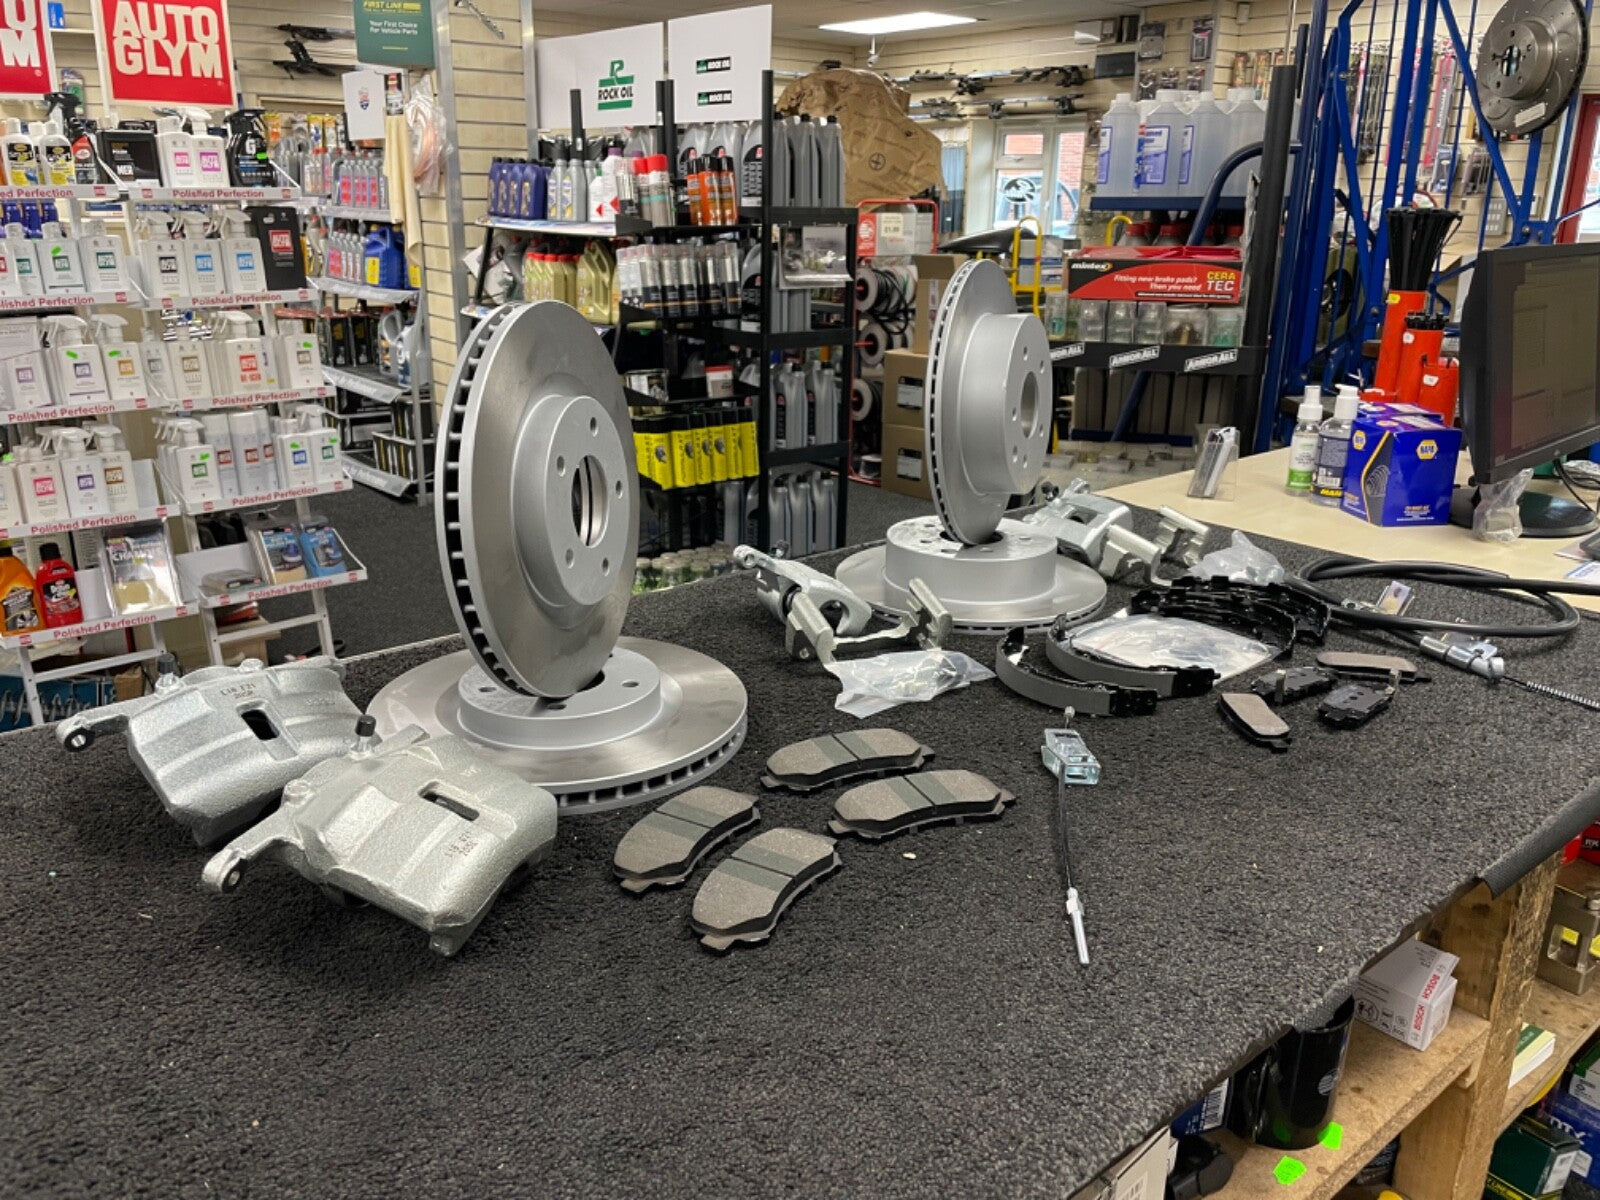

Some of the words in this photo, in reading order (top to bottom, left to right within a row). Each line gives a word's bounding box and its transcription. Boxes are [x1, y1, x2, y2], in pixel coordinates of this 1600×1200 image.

[112, 1, 220, 45] AUTO
[384, 20, 397, 28] First
[113, 38, 223, 79] GLYM
[598, 86, 619, 100] ROCK
[620, 86, 634, 98] OIL
[16, 188, 74, 198] Perfection
[172, 189, 215, 198] Polished
[217, 188, 264, 198] Perfection
[1071, 262, 1107, 271] mintex
[1114, 274, 1137, 283] Fitting
[1176, 276, 1197, 284] pads?
[1207, 271, 1237, 281] CERA
[1207, 281, 1235, 291] TEC
[38, 296, 95, 307] Perfection
[191, 297, 234, 306] Polished
[236, 294, 282, 304] Perfection
[1186, 356, 1219, 371] ARMOR
[1218, 351, 1236, 363] ALL
[212, 395, 253, 406] Polished
[255, 391, 301, 401] Perfection
[8, 408, 58, 423] Polished
[60, 404, 116, 418] Perfection
[232, 493, 272, 506] Polished
[274, 486, 319, 500] Perfection
[31, 519, 79, 533] Polished
[82, 514, 137, 528] Perfection
[247, 588, 288, 600] Polished
[289, 579, 333, 592] Perfection
[53, 624, 101, 639] Polished
[104, 614, 157, 630] Perfection
[1422, 973, 1441, 1000] BOSCH
[1413, 1004, 1426, 1031] BOSCH
